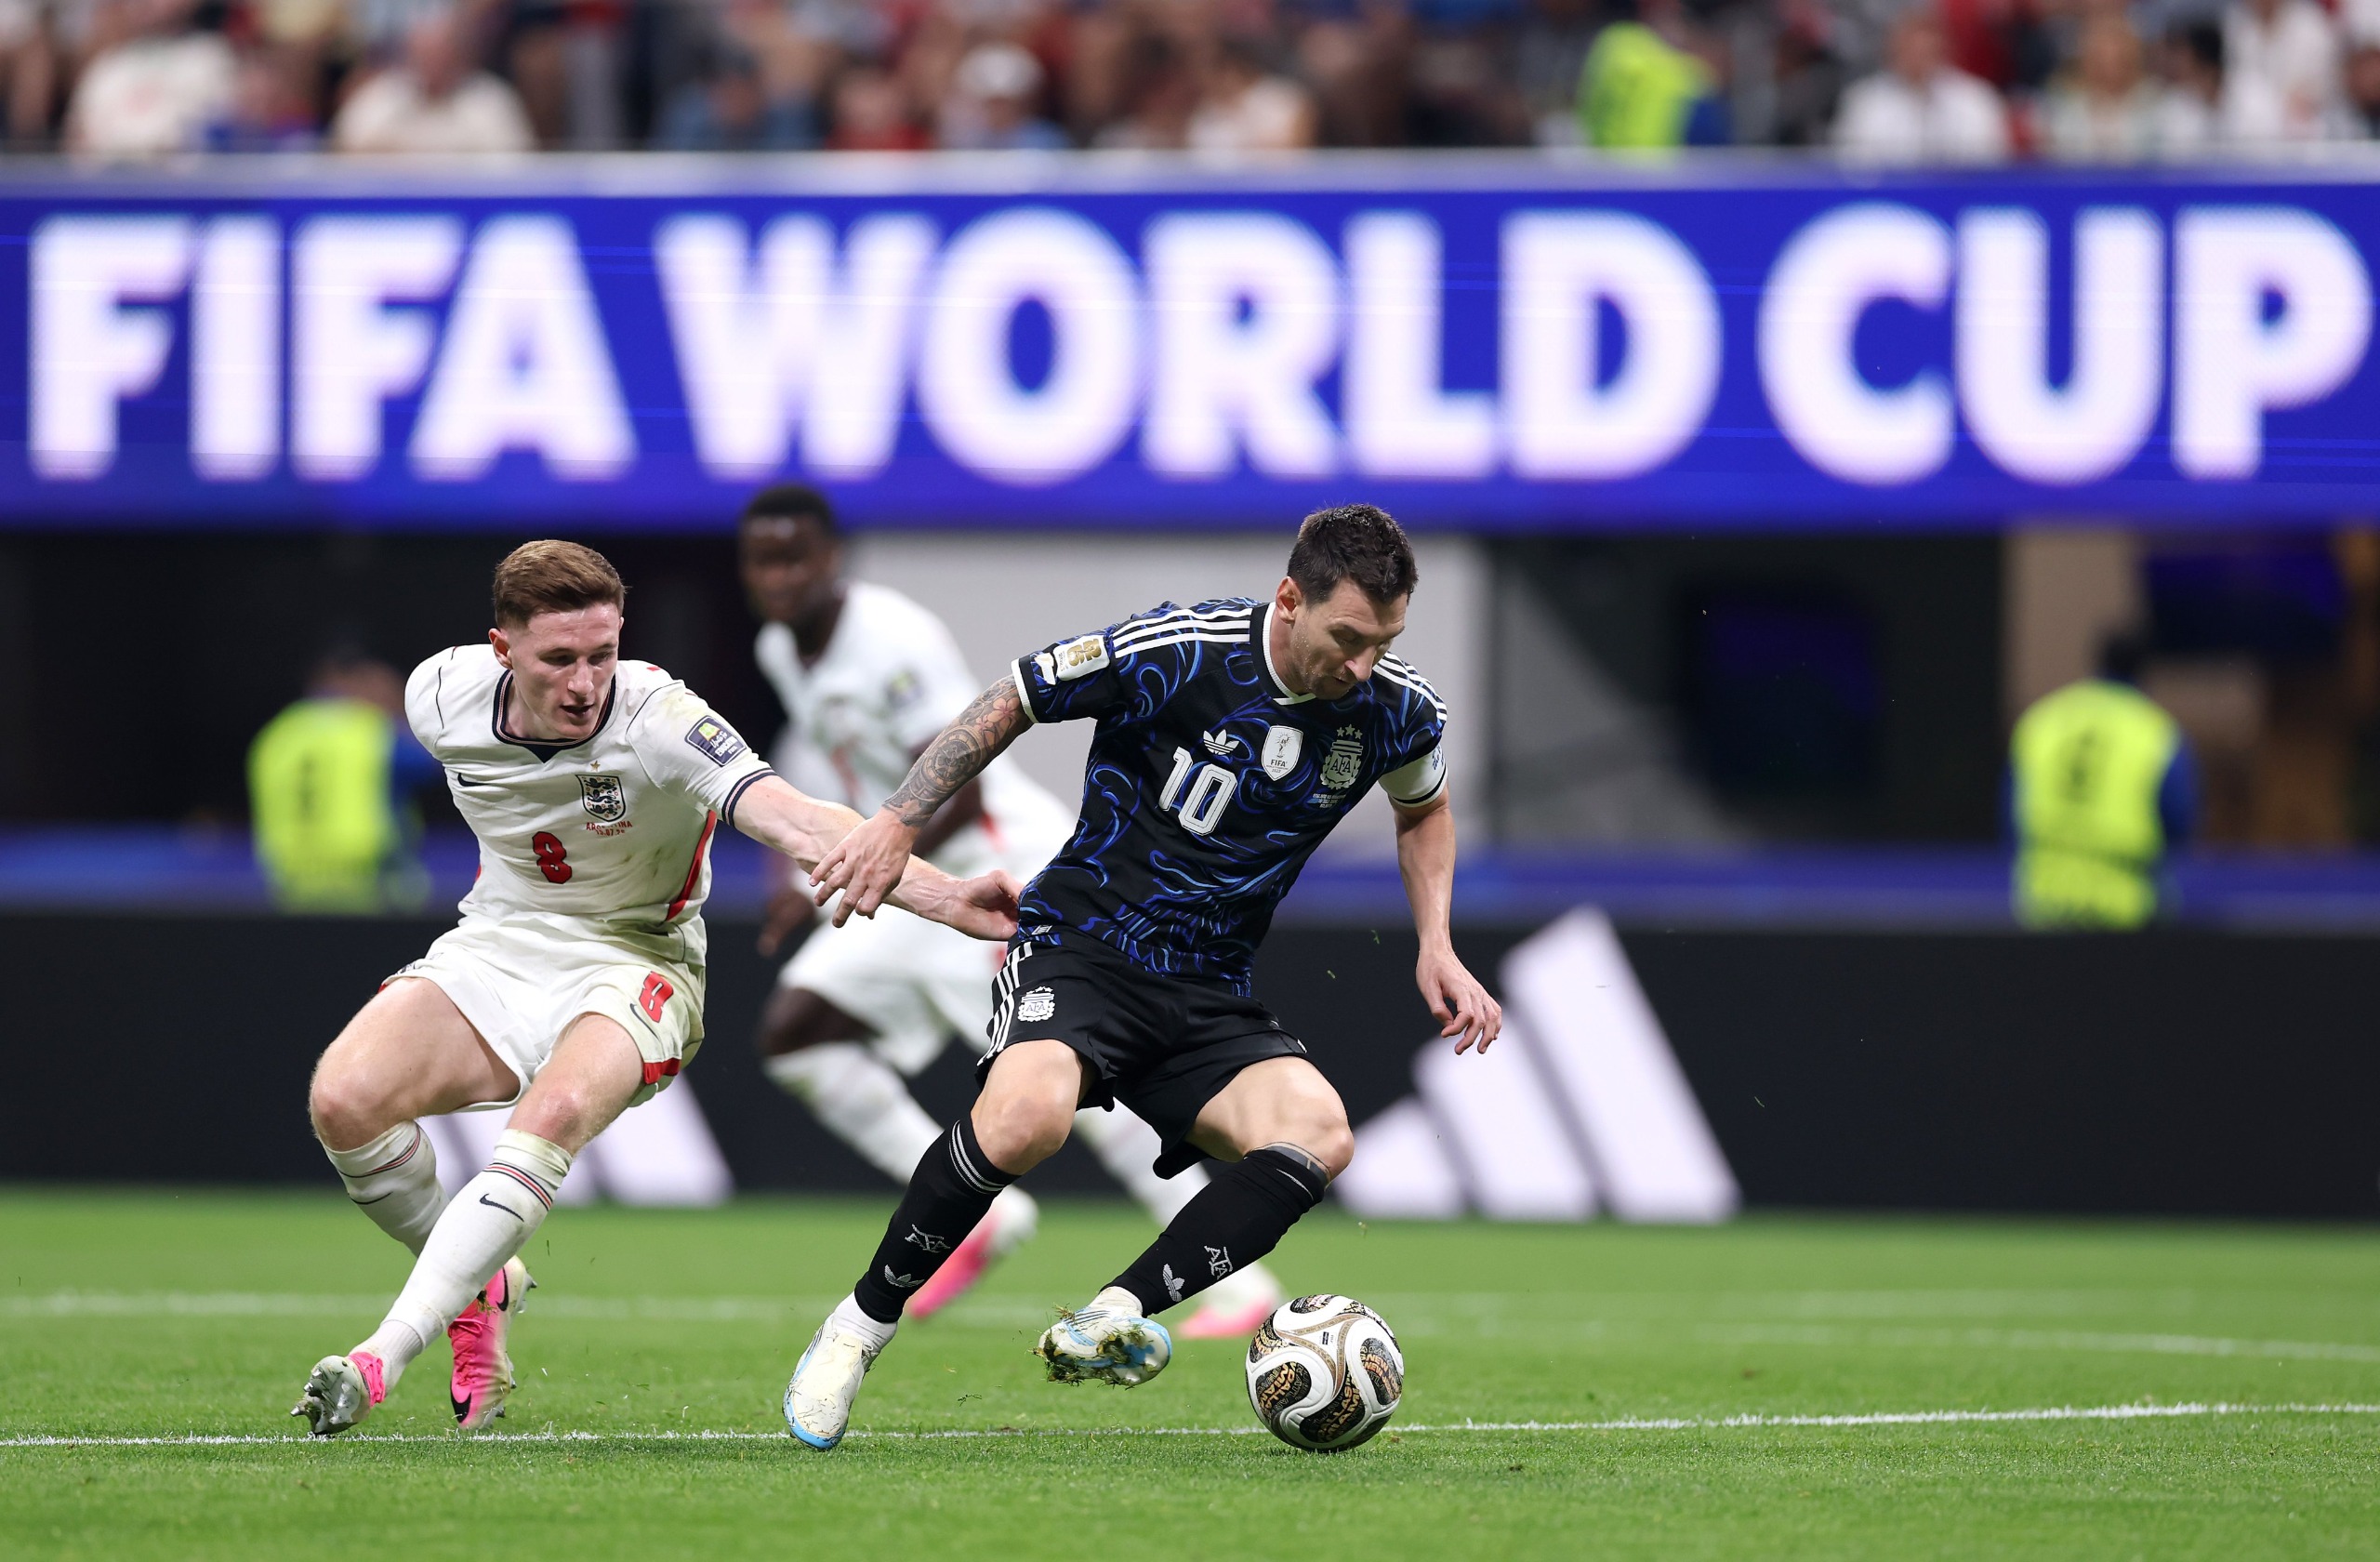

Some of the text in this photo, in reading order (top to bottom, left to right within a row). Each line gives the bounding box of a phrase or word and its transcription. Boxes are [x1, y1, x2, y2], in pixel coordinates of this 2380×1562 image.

[28, 200, 2374, 485] FIFA WORLD CUP
[1270, 759, 1286, 768] FIFA
[1329, 753, 1352, 776] AFA
[1158, 746, 1238, 837] 10
[586, 820, 633, 831] ARGINA
[532, 830, 573, 884] 8
[638, 971, 675, 1024] 8
[1203, 1245, 1234, 1281] AFA
[1263, 1368, 1295, 1411] DALLA
